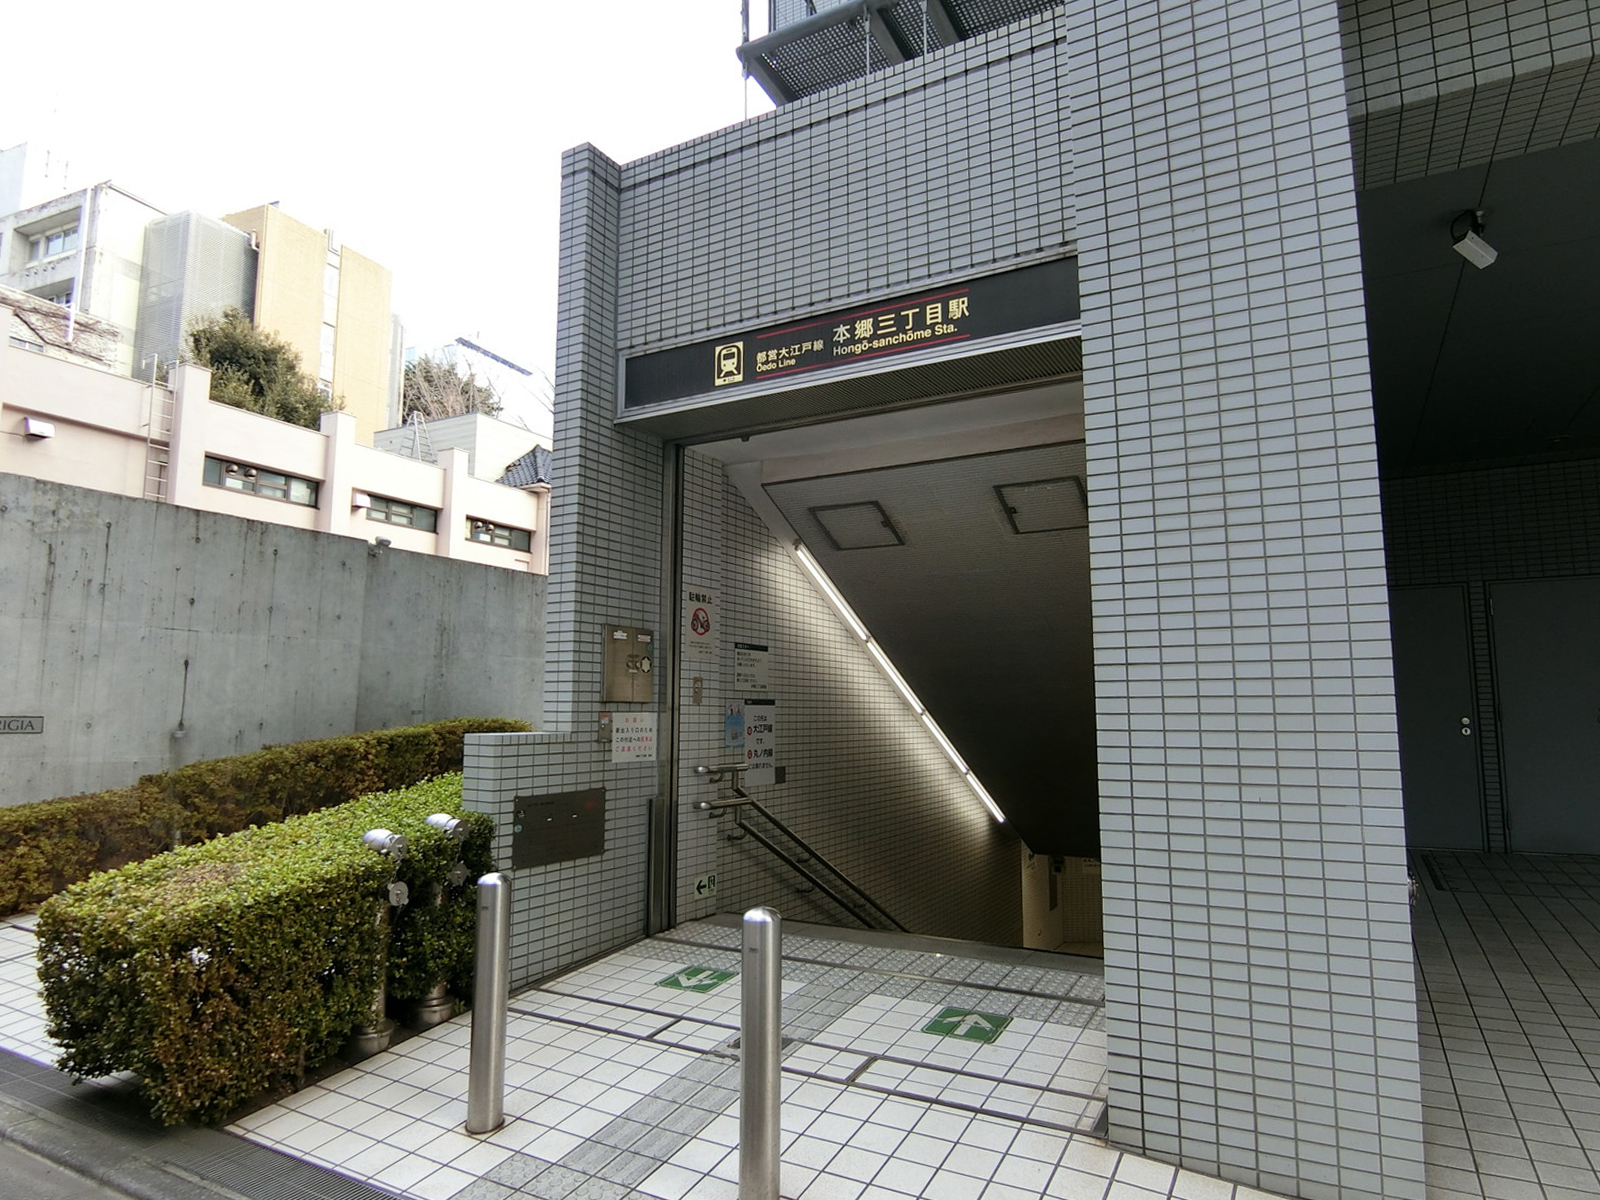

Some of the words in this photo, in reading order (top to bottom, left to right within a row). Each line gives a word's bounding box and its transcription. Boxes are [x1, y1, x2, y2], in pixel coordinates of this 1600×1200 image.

[832, 297, 970, 344] 本郷三丁目駅
[756, 339, 825, 364] 都営大江戸線
[833, 328, 932, 357] Hongō-sanchōme
[934, 322, 958, 336] Sta.
[779, 358, 796, 368] Line
